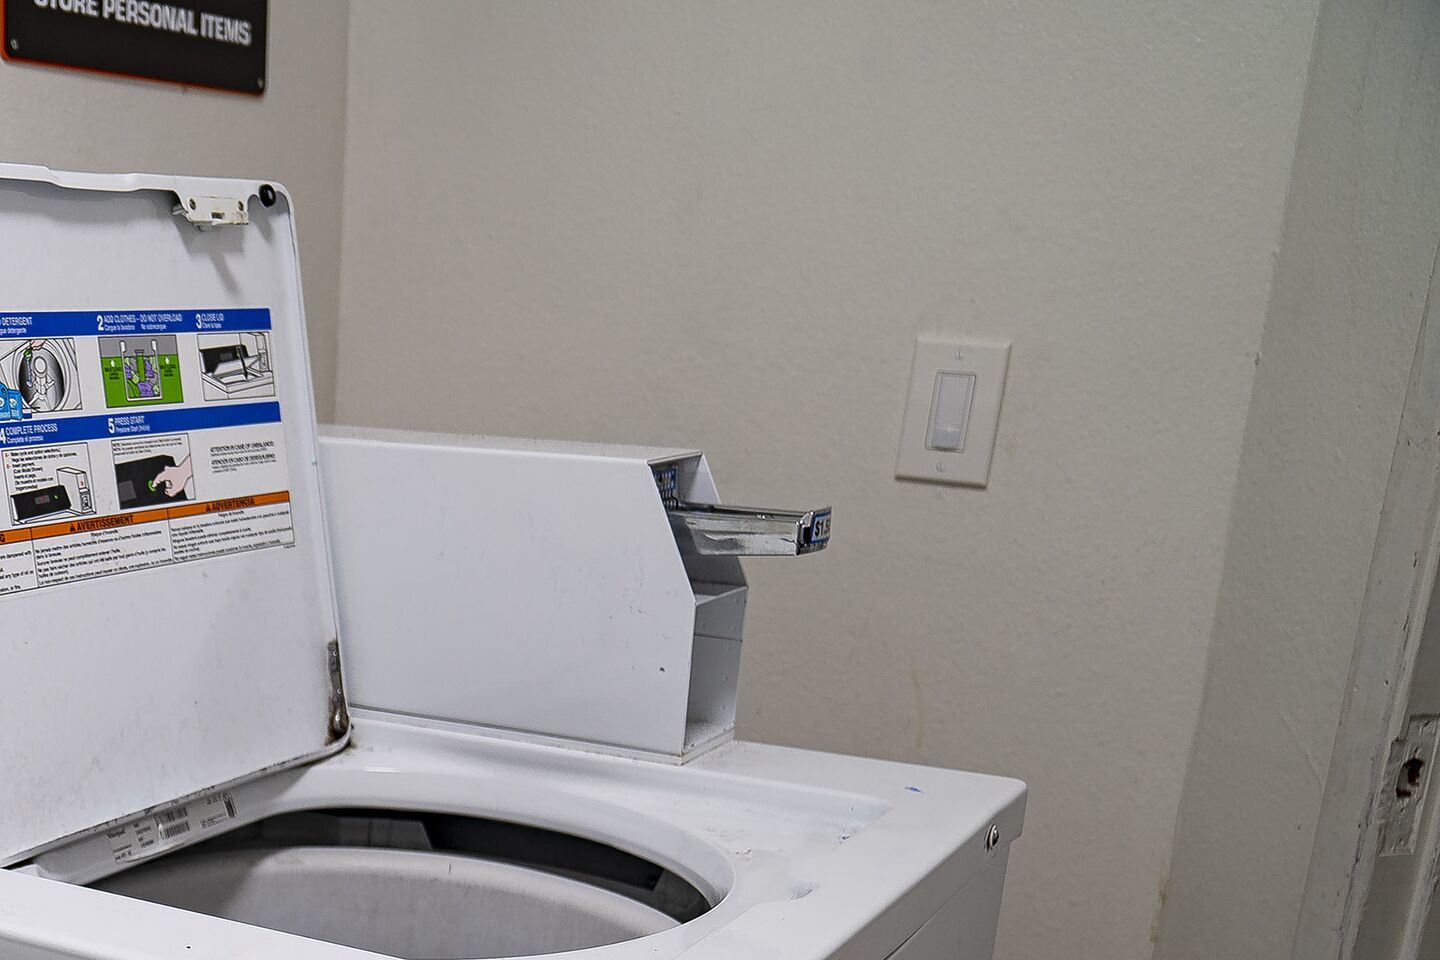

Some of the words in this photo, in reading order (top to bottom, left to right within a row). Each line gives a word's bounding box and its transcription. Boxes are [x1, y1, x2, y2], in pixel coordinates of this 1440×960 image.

[103, 0, 198, 35] PERSONAL
[200, 13, 252, 45] ITEMS
[2, 317, 32, 325] DETERGENT
[97, 315, 104, 331] 2
[196, 313, 201, 329] 3
[108, 419, 115, 434] 5
[115, 417, 131, 425] PRESS
[131, 416, 145, 424] START
[0, 427, 6, 444] 4
[6, 425, 33, 435] COMPLETE
[34, 424, 58, 433] PROCESS
[78, 515, 134, 531] AVERTISSEMENT
[815, 518, 831, 538] $1.5
